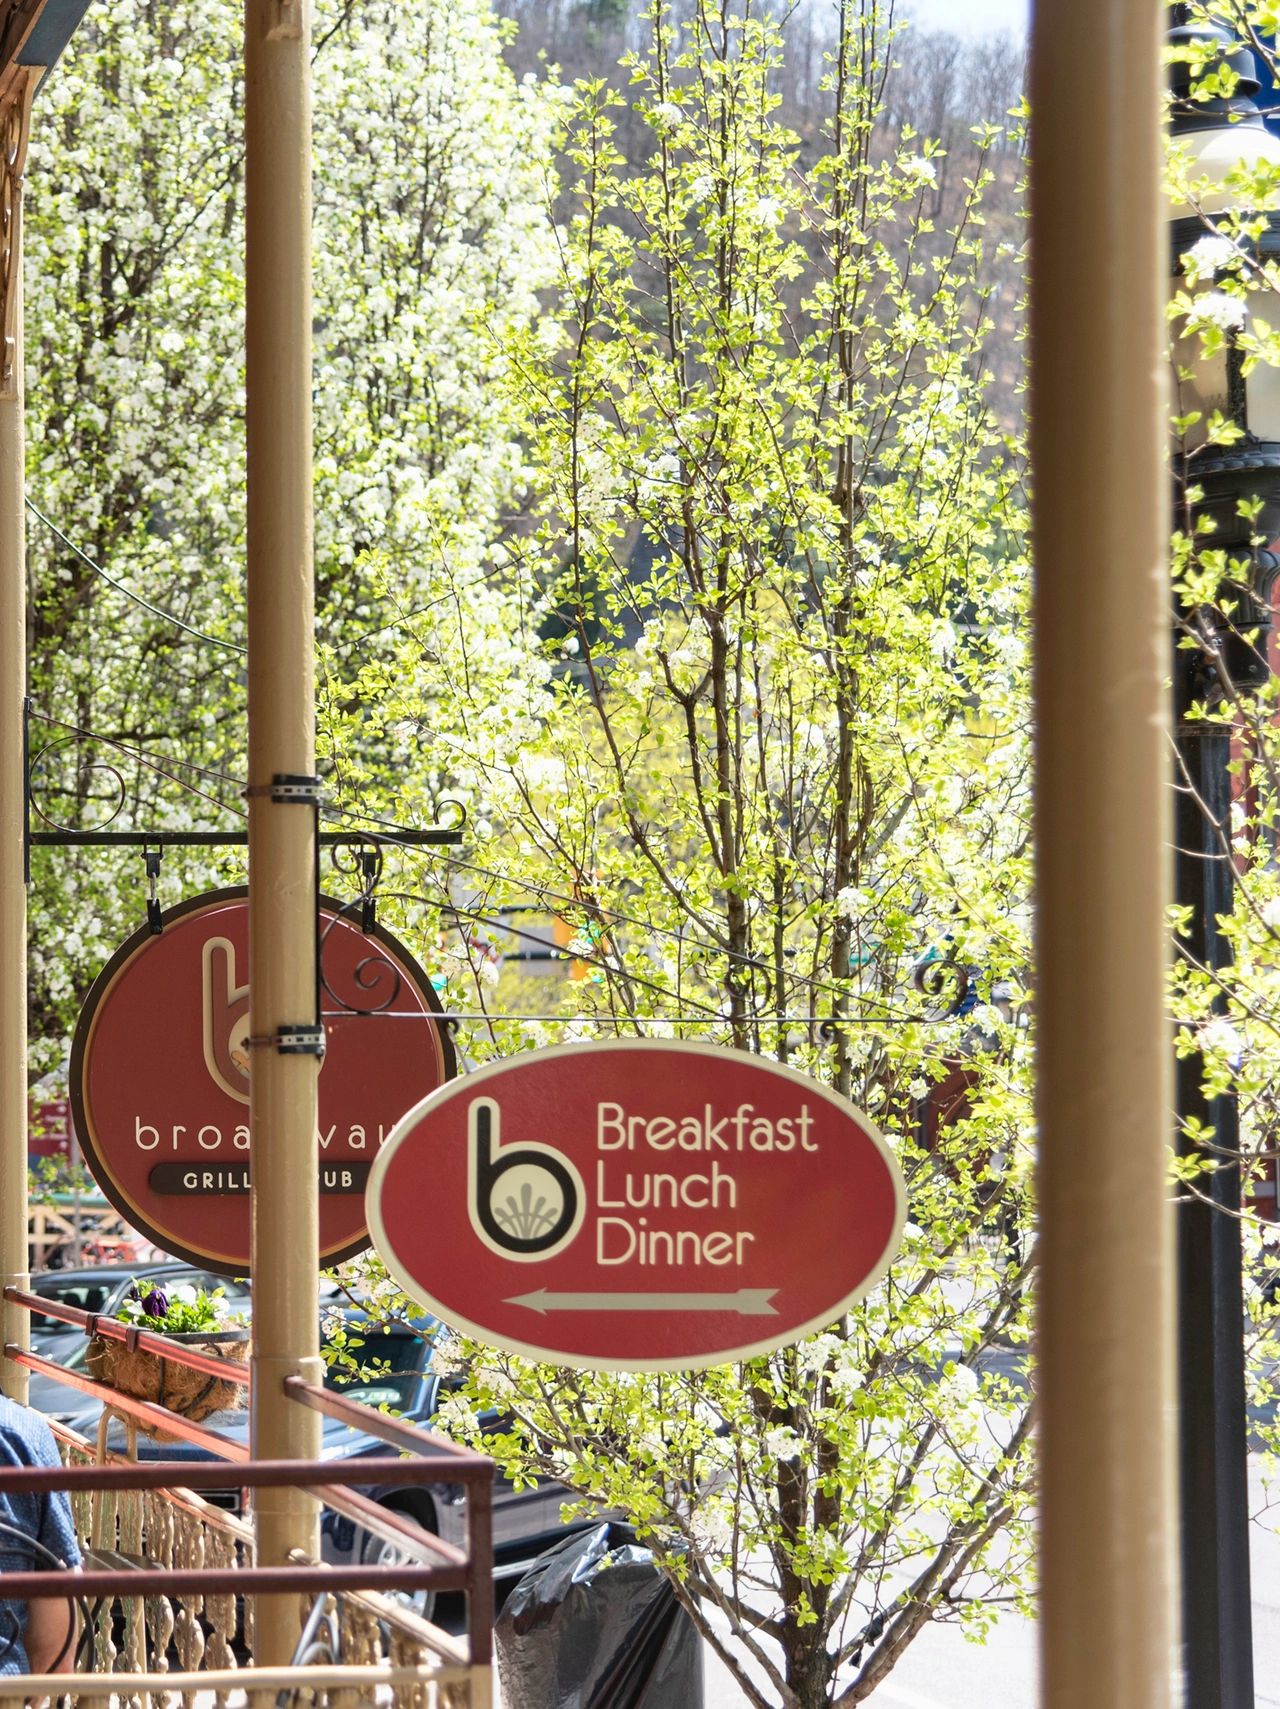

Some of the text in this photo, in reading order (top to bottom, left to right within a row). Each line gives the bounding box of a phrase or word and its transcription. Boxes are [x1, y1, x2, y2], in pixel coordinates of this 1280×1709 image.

[135, 1116, 397, 1150] broaa
[597, 1102, 818, 1151] Breakfast
[183, 1170, 353, 1189] GRILL UB
[597, 1160, 736, 1208] Lunch
[597, 1217, 755, 1266] Dinner
